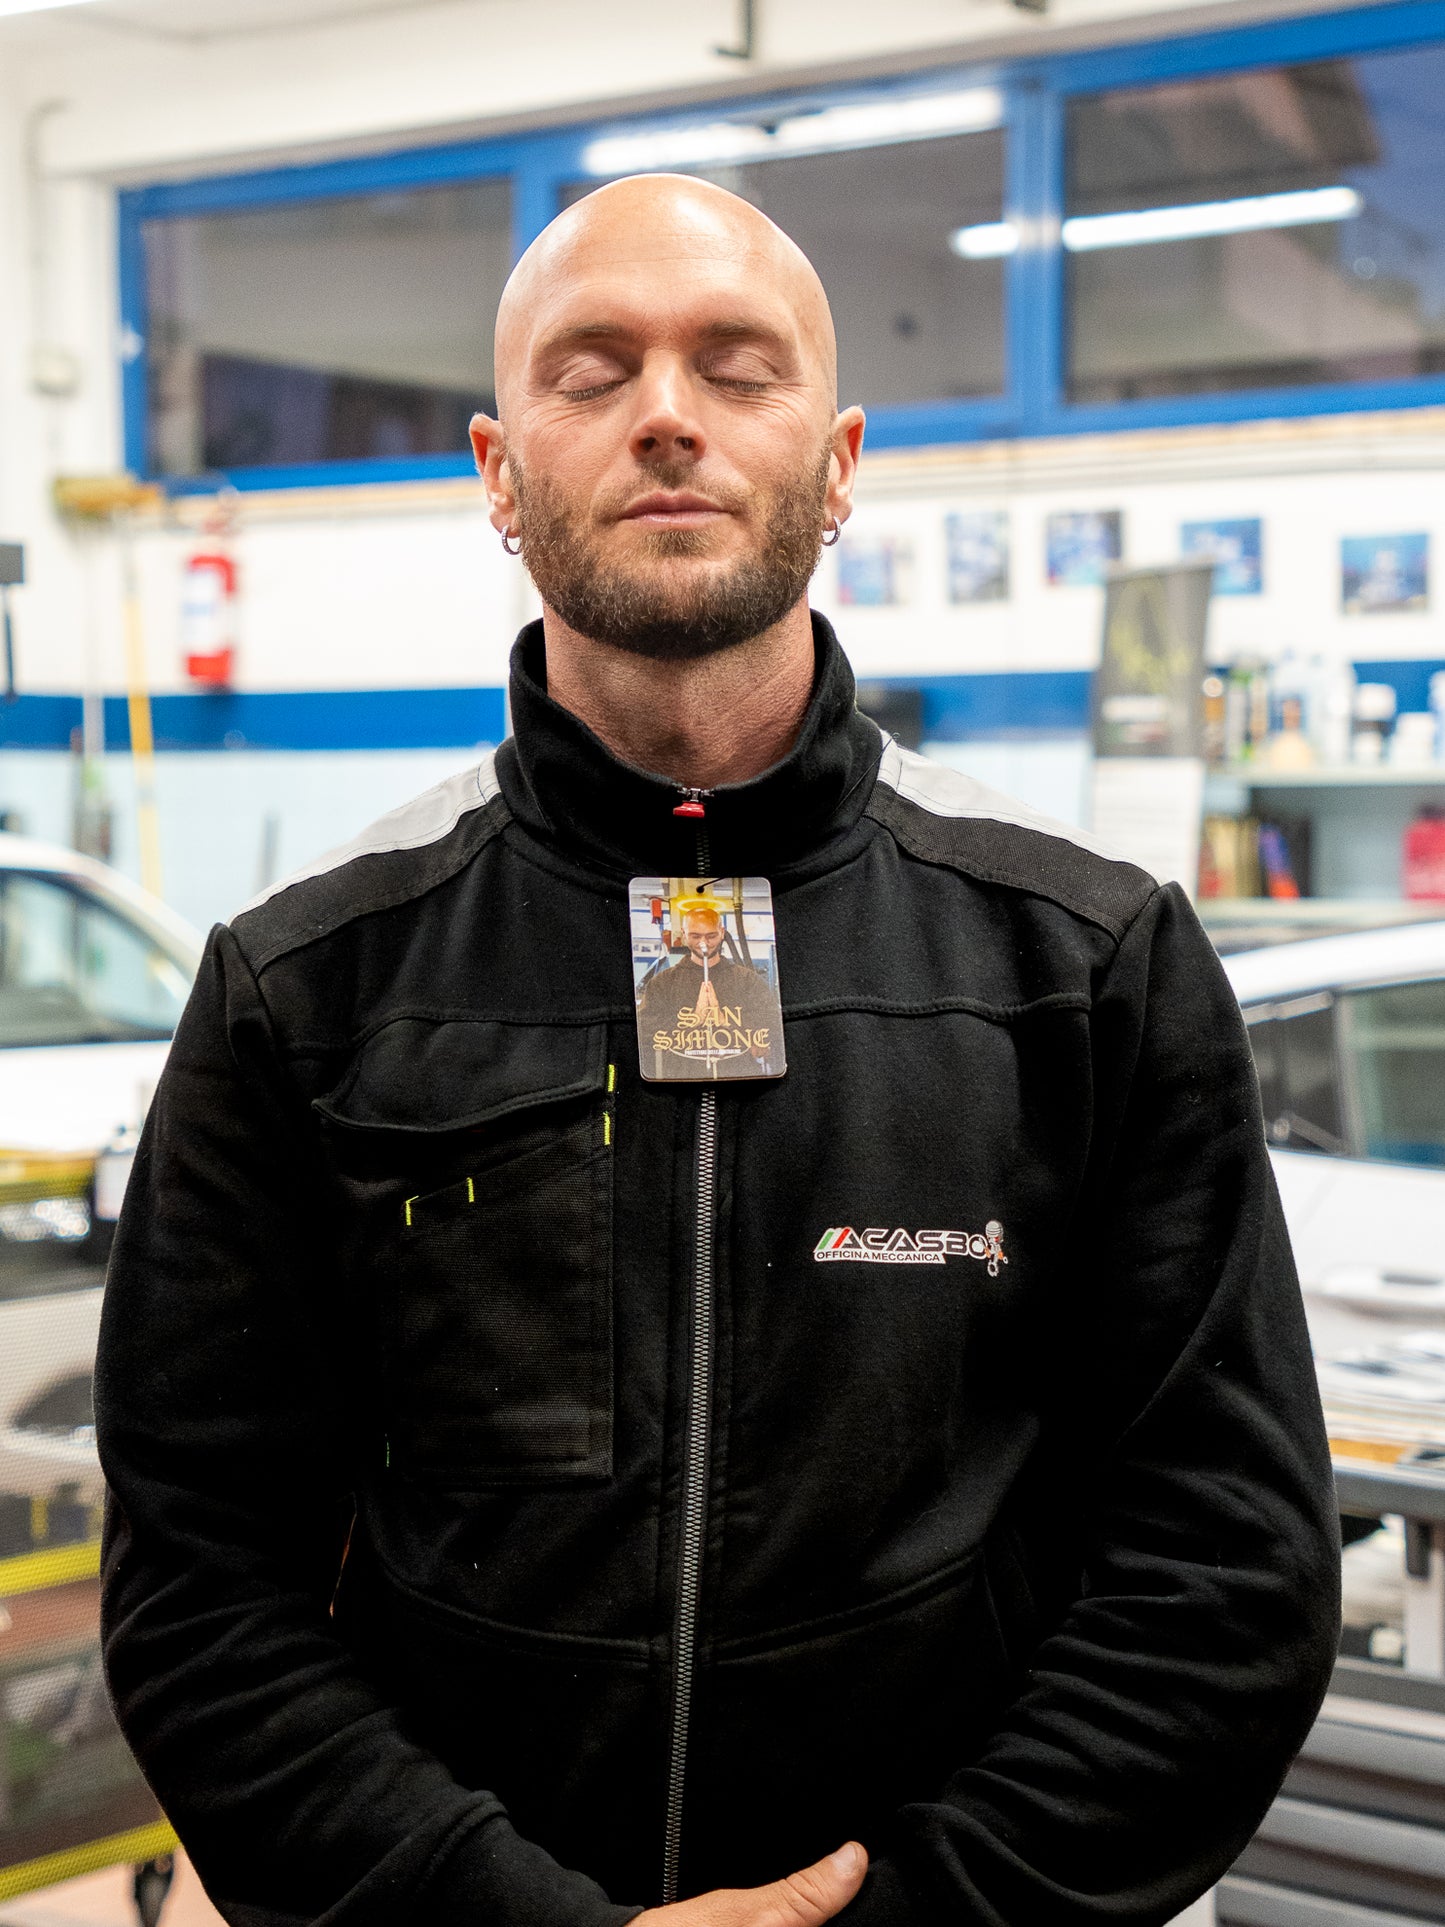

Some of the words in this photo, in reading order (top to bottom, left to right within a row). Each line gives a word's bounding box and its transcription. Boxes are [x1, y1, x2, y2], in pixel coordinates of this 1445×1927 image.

[677, 1006, 742, 1028] SAN
[652, 1029, 770, 1050] SIMONE
[817, 1251, 869, 1260] OFFICINA
[871, 1252, 941, 1262] MECCANICA
